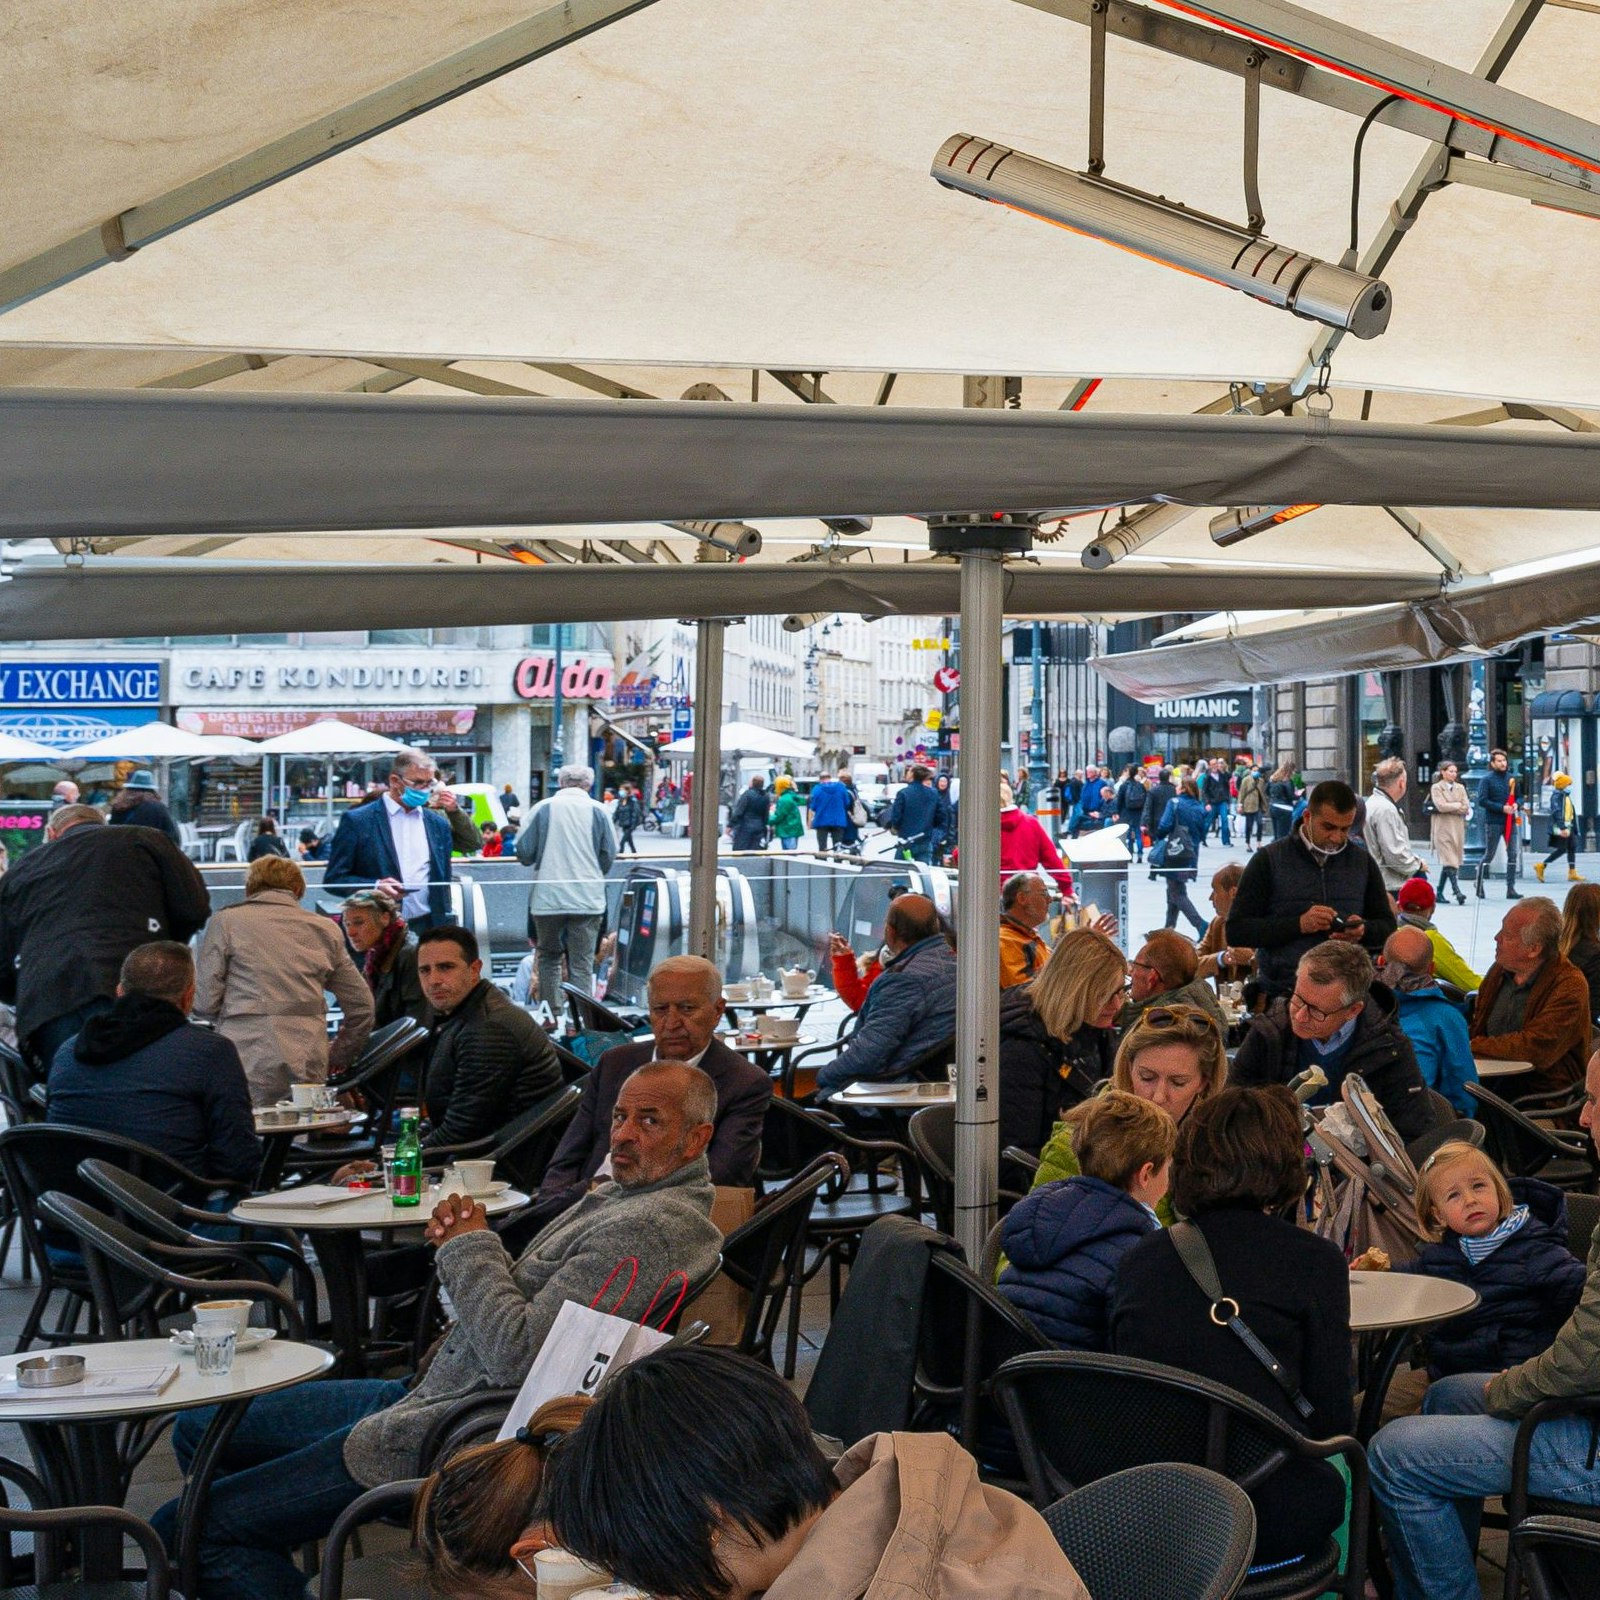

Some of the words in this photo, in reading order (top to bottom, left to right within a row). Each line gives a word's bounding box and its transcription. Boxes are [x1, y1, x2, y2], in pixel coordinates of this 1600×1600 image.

[17, 670, 159, 700] EXCHANGE
[278, 666, 482, 688] KONDITOREI
[356, 711, 380, 722] THE
[1154, 699, 1240, 718] HUMANIC
[404, 720, 449, 731] CREAM
